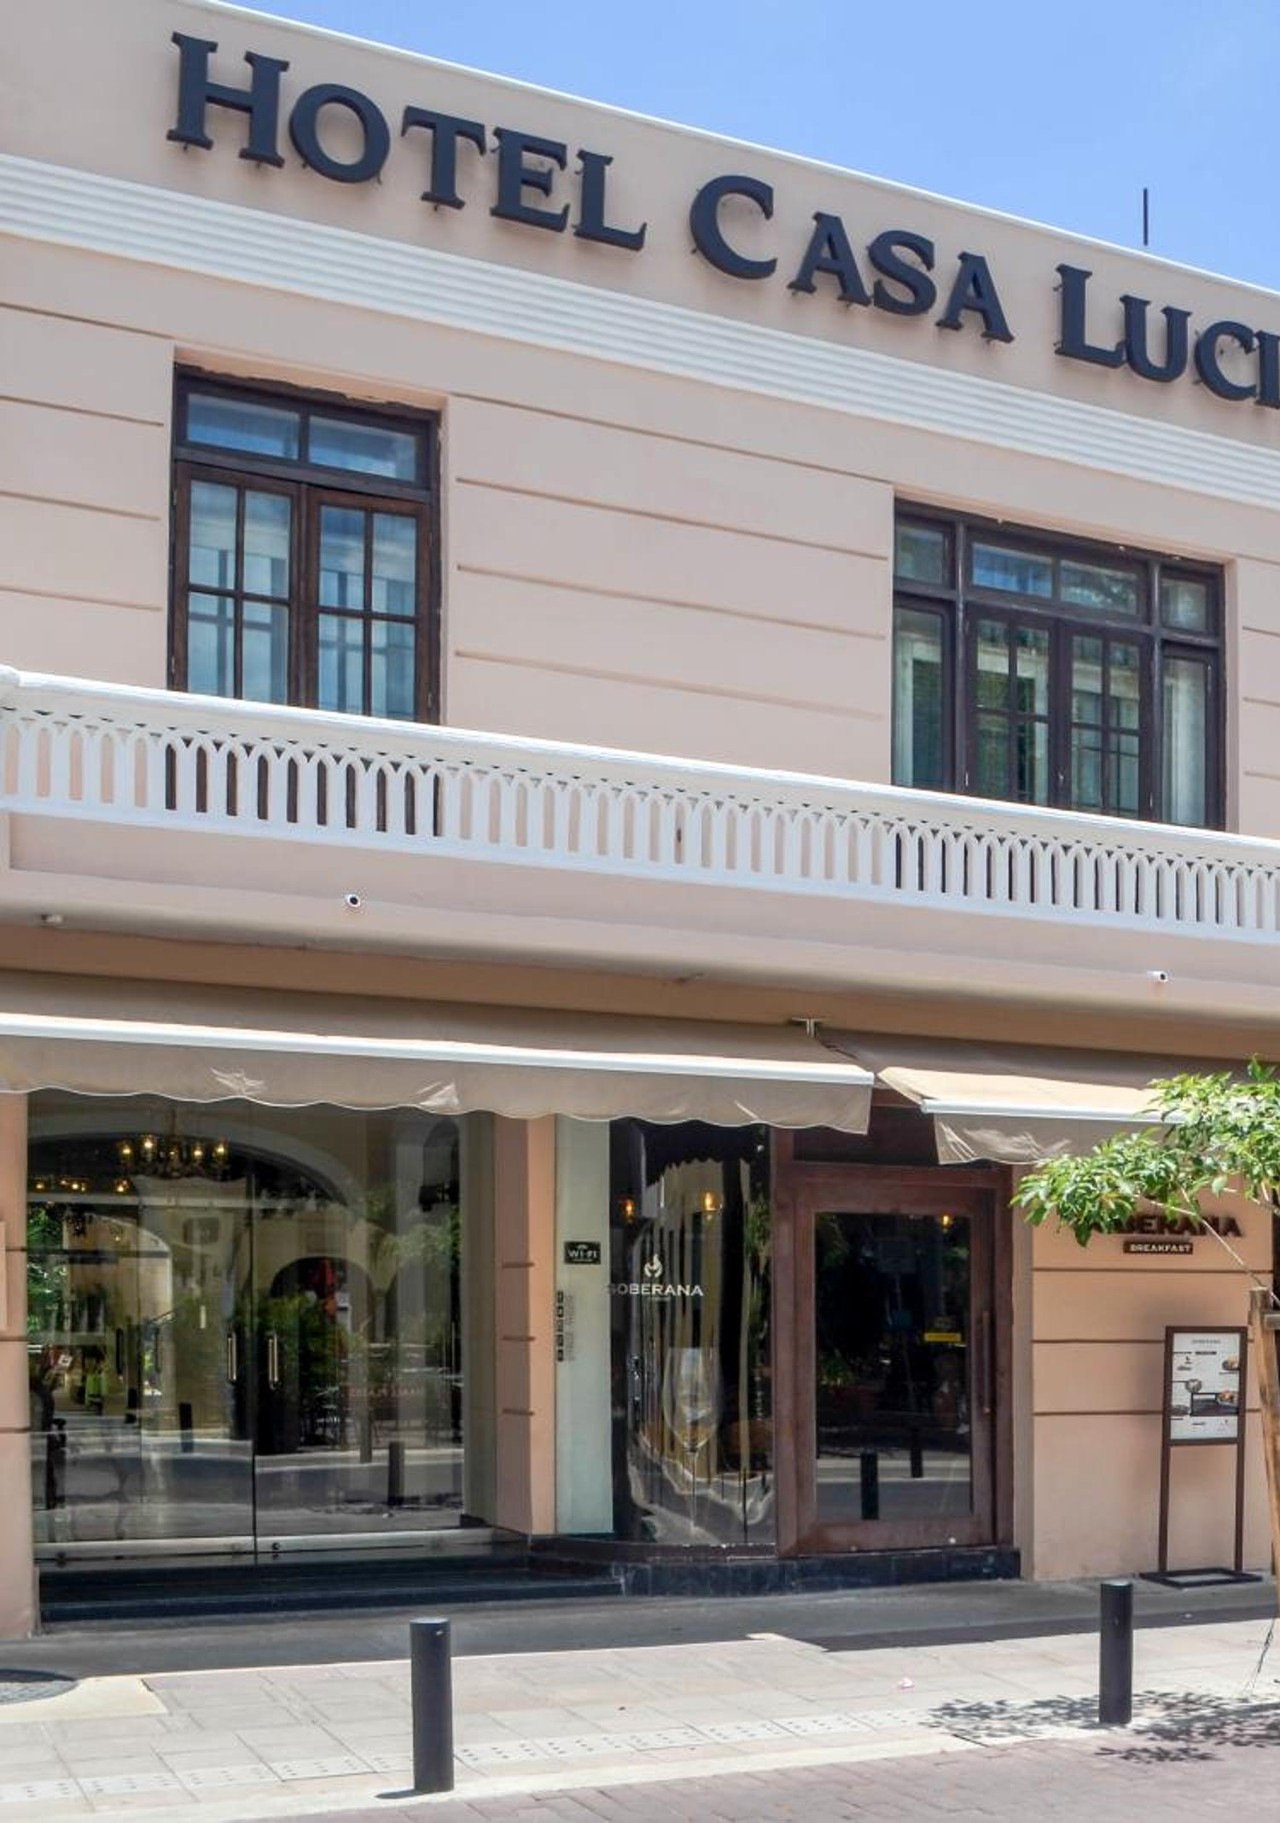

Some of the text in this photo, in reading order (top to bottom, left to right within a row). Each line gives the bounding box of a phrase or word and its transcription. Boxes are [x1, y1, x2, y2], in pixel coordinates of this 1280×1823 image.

[166, 31, 648, 252] HOTEL
[689, 174, 1015, 345] CASA
[1129, 1243, 1192, 1253] BREAKFAST
